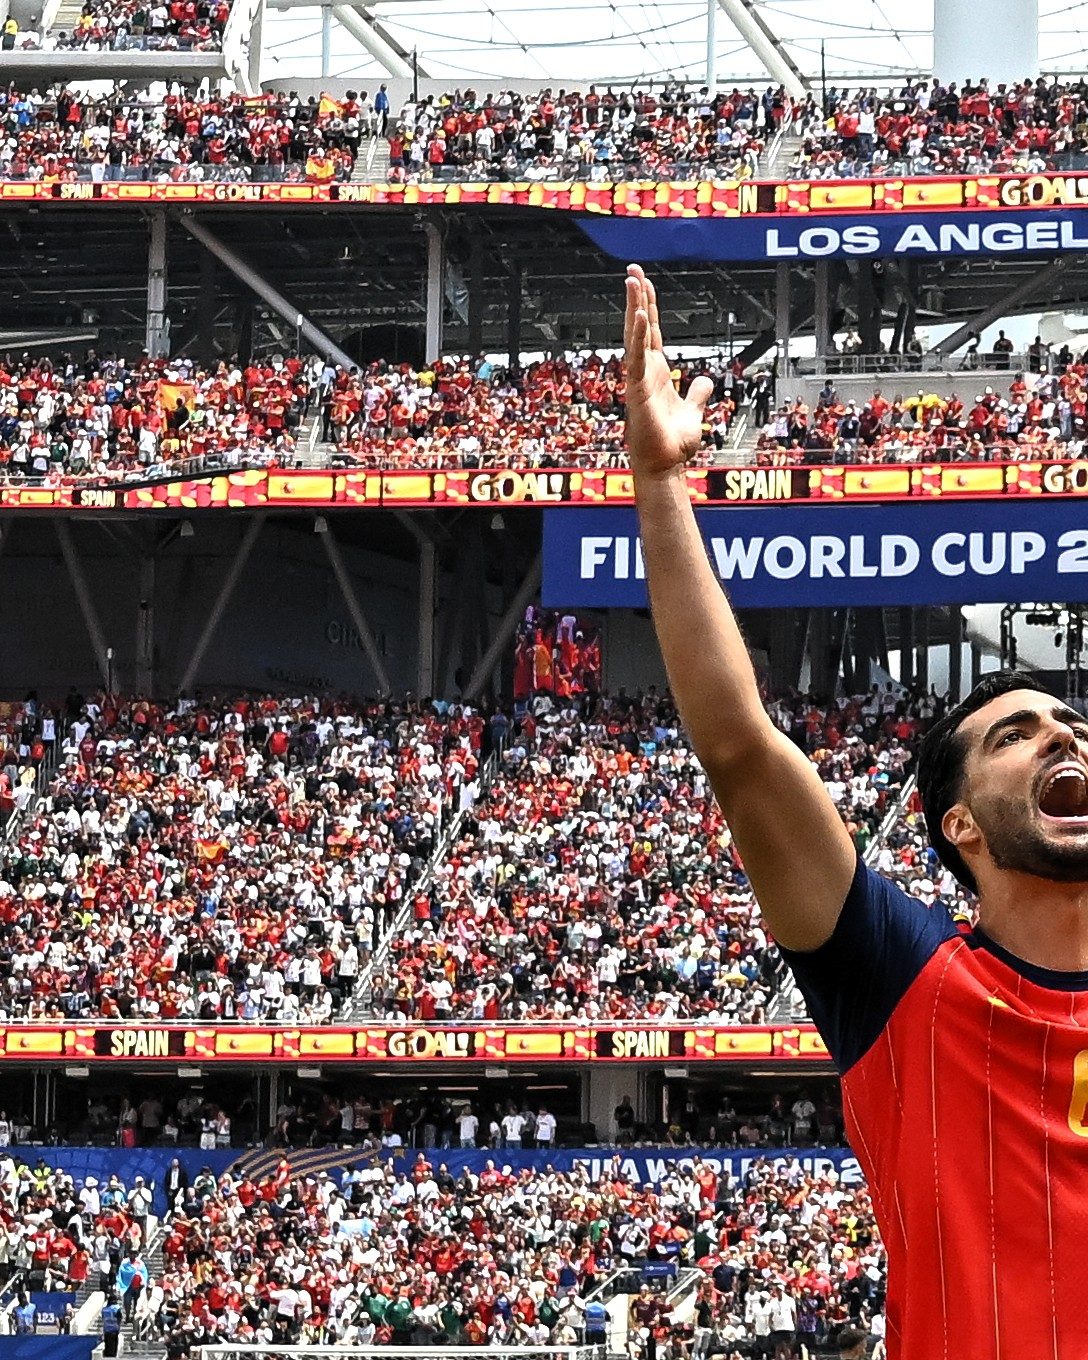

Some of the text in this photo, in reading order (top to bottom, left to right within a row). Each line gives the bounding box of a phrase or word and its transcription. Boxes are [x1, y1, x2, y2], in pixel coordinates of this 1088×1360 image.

[60, 183, 371, 200] SPAIN GOAL! SPAIN
[766, 226, 880, 257] LOS
[80, 489, 116, 507] SPAIN
[471, 470, 562, 501] GOAL!
[725, 469, 792, 500] SPAIN
[711, 535, 920, 579] WORLD
[932, 532, 1046, 575] CUP
[111, 1030, 169, 1057] SPAIN
[388, 1028, 469, 1057] GOAL!
[612, 1030, 669, 1058] SPAIN
